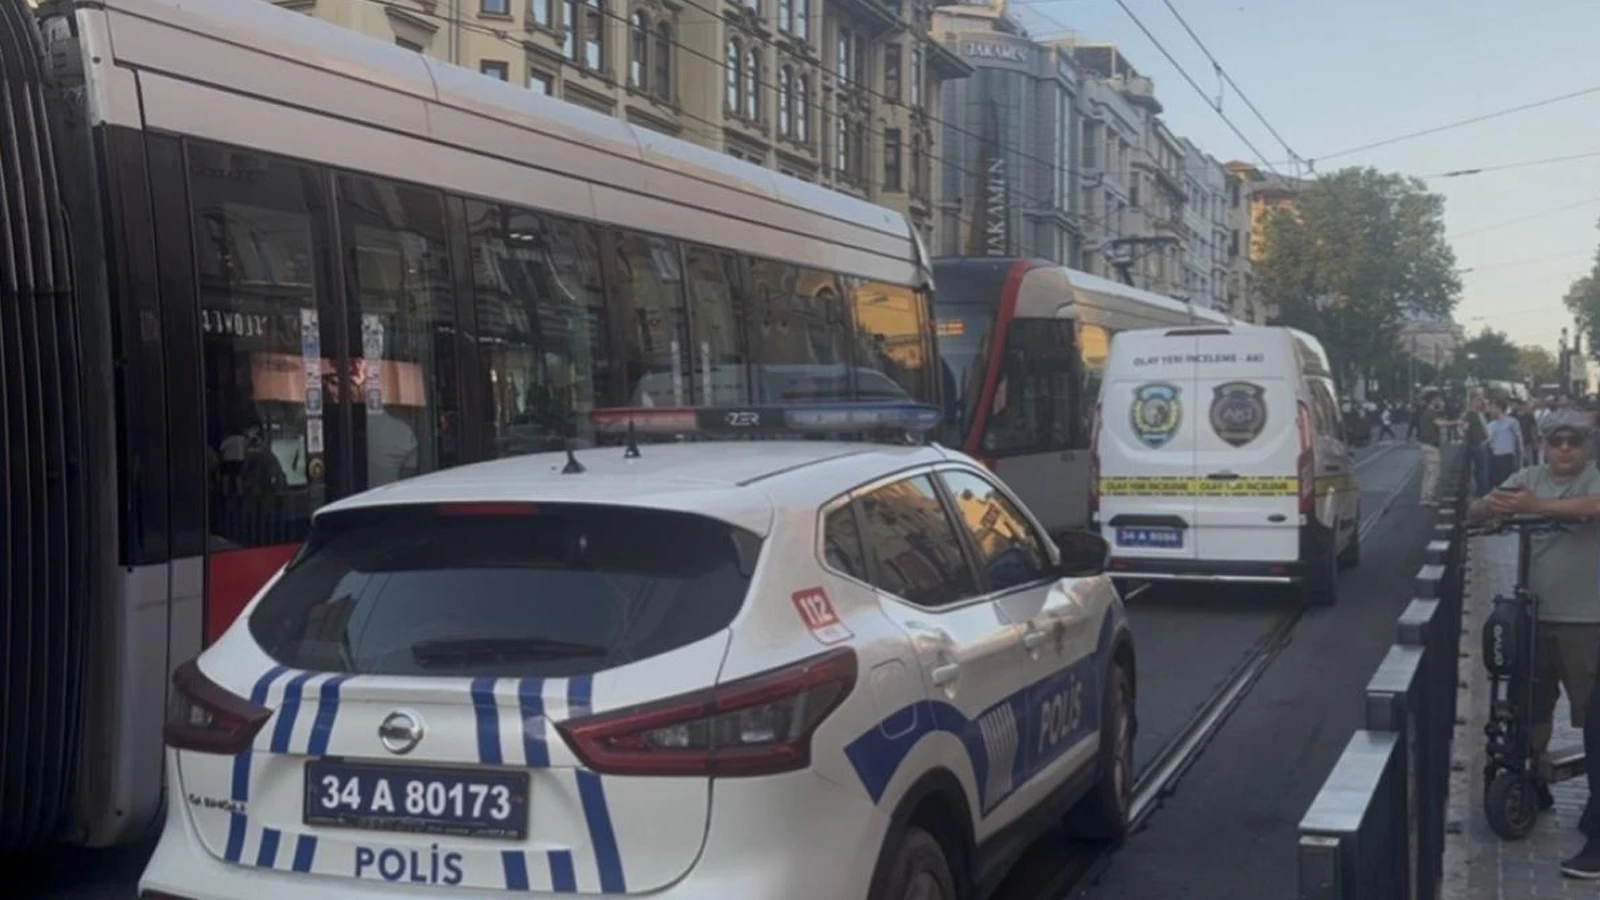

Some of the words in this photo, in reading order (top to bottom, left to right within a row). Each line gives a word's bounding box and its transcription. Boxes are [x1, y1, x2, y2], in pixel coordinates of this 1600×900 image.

[799, 594, 834, 625] 112
[321, 775, 361, 810] 34
[370, 779, 395, 813] A
[405, 781, 512, 819] 80173
[354, 843, 464, 885] POLİS
